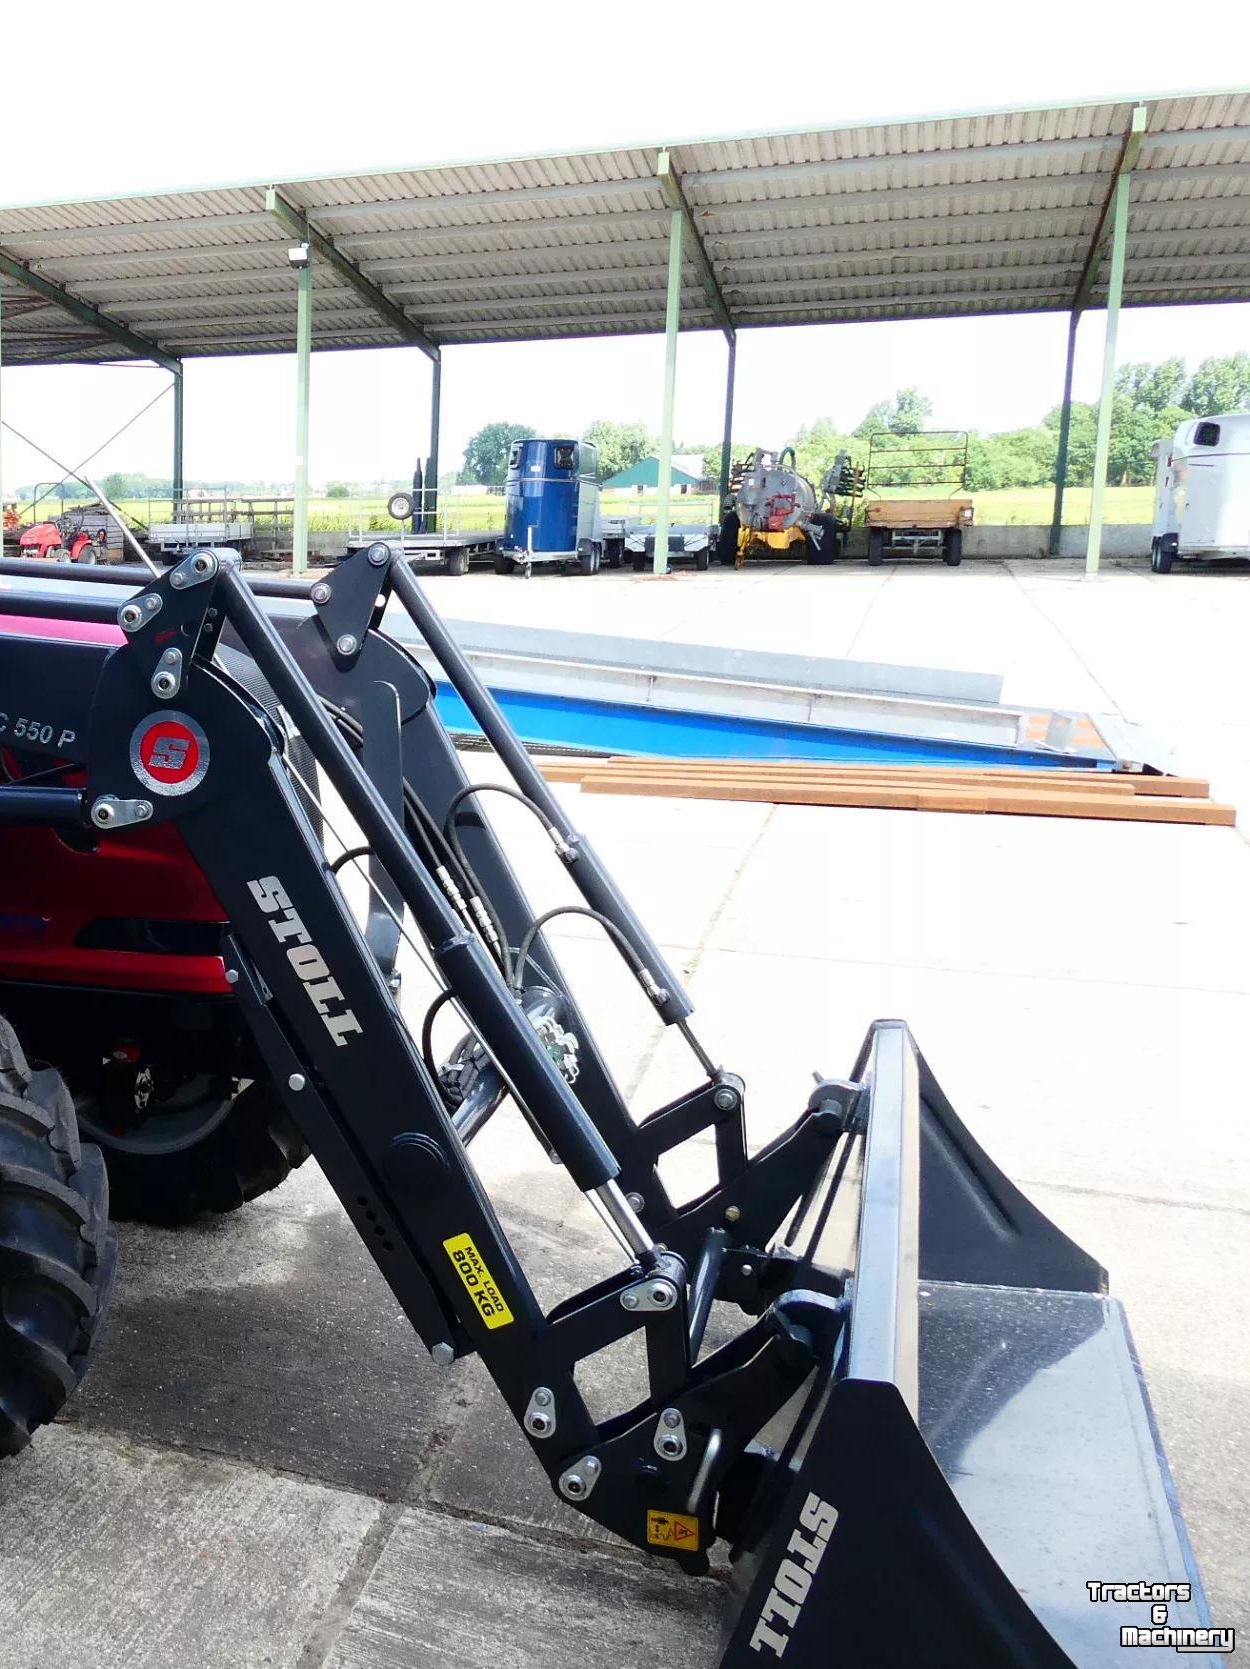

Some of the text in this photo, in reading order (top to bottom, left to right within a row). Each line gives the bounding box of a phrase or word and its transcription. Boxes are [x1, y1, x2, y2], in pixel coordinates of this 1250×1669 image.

[13, 717, 53, 744] 550
[57, 729, 76, 748] P
[246, 875, 364, 1047] STOLL
[452, 1250, 495, 1317] 800 KG
[465, 1246, 504, 1312] MAX. LOAD
[749, 1491, 839, 1658] STOLL
